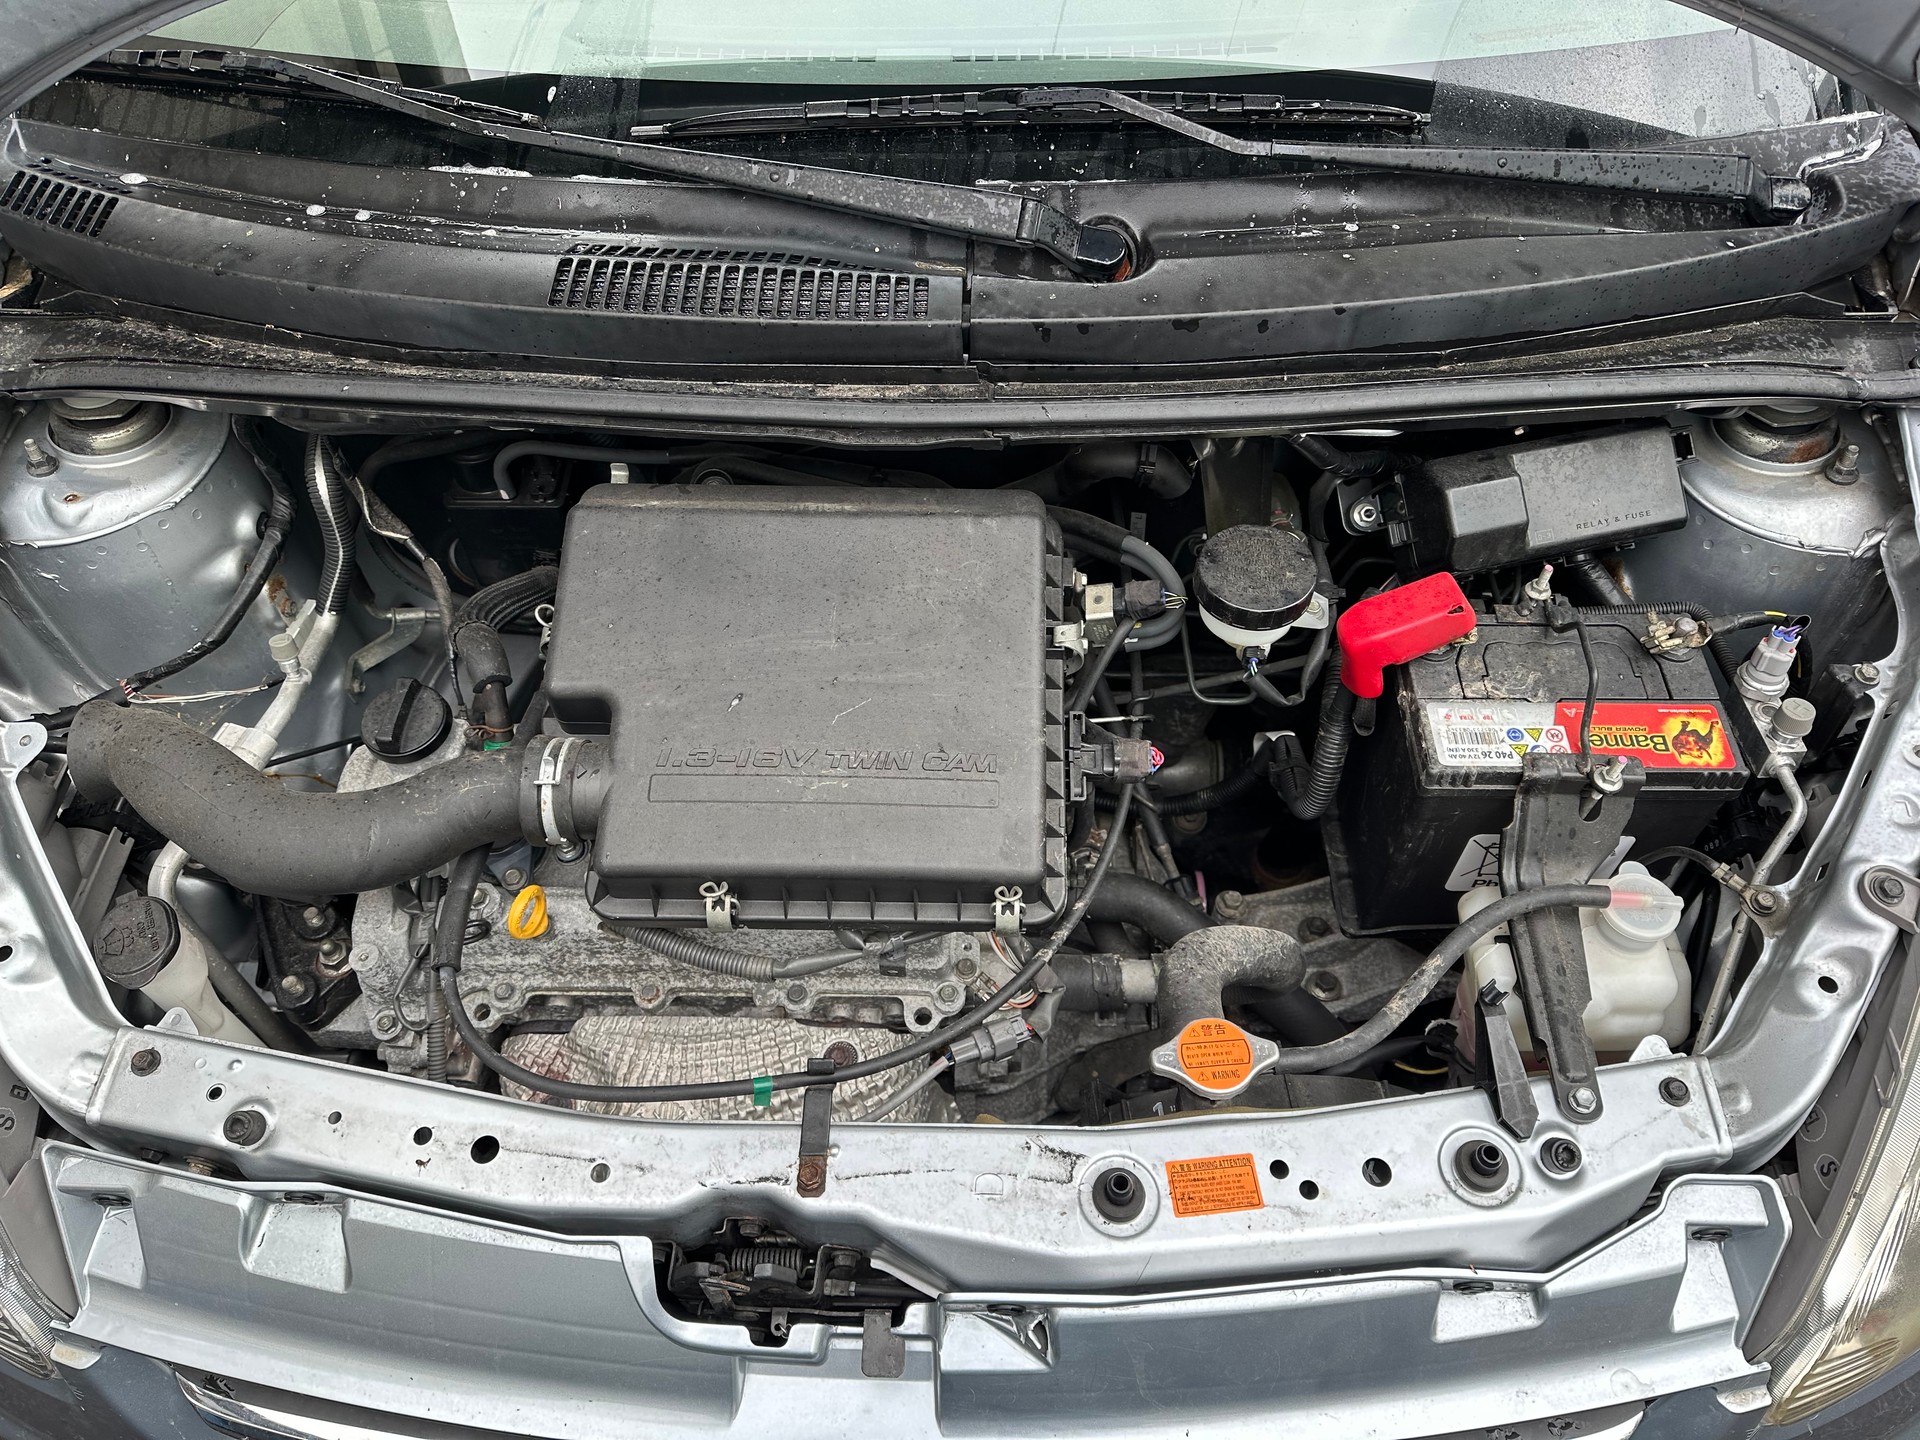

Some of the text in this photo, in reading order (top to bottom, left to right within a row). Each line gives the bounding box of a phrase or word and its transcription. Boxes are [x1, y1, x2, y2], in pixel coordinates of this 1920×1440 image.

[1576, 518, 1609, 530] RELAY
[1625, 510, 1652, 520] FUSE
[1589, 734, 1671, 752] Banne
[656, 746, 997, 773] 1.3-16V TWIN CAM
[1481, 750, 1514, 760] P40 26
[1200, 1024, 1226, 1036] 警告
[1211, 1069, 1240, 1080] WARNING
[1192, 1160, 1218, 1170] WARNING
[1218, 1158, 1252, 1168] ATTENTION
